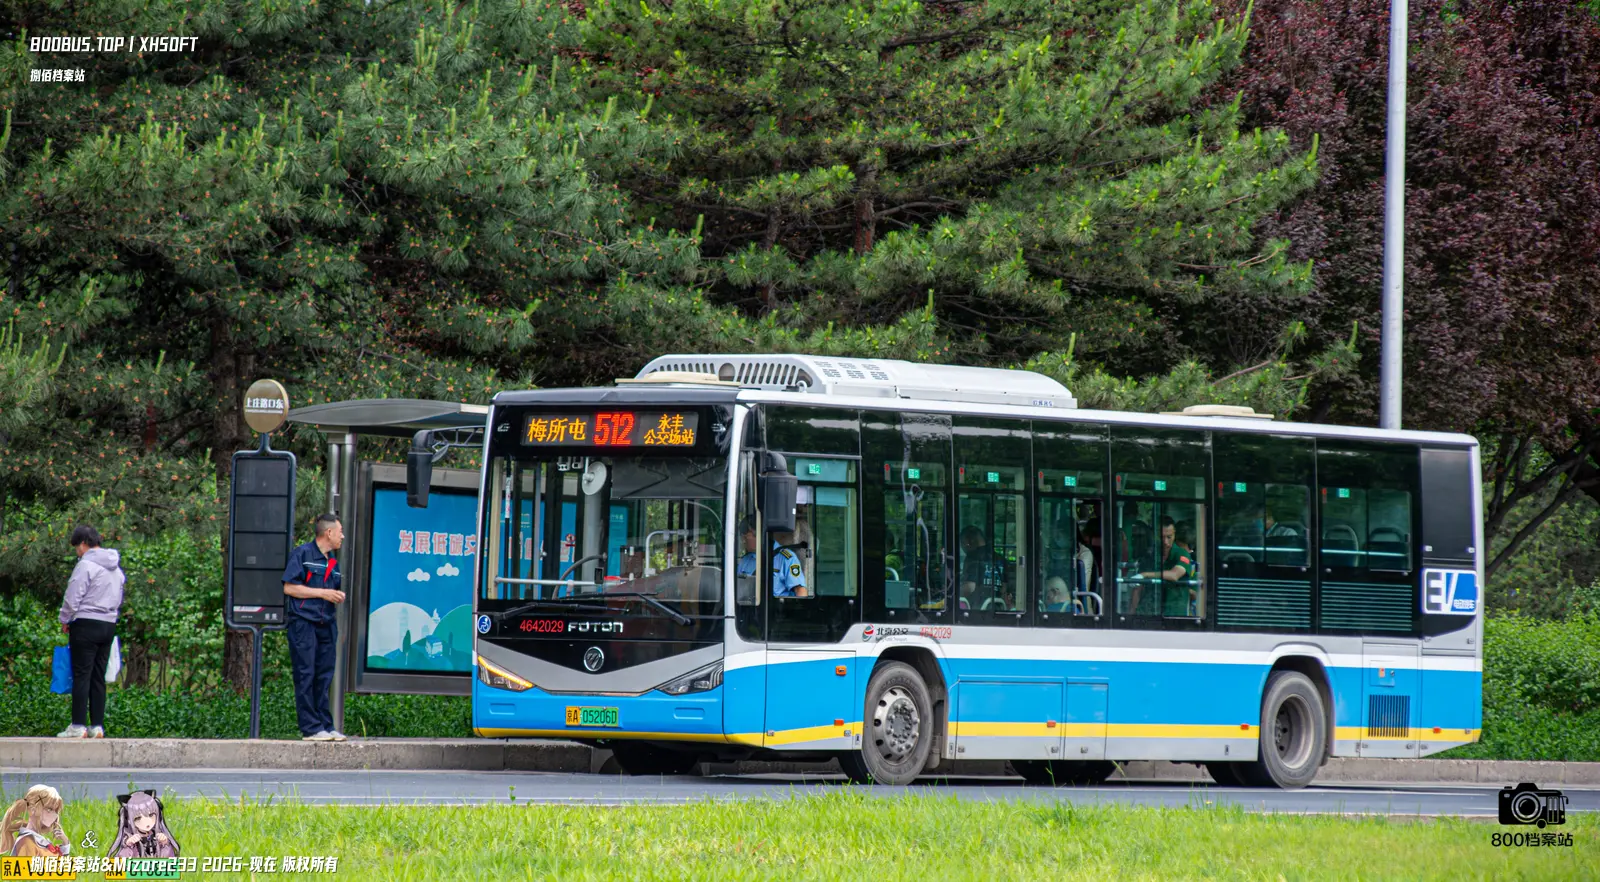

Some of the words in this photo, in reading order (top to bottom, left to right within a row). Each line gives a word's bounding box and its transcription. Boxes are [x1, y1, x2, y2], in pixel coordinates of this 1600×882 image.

[527, 418, 587, 443] 梅所屯
[594, 413, 635, 446] 512
[658, 413, 684, 431] 永丰
[643, 429, 695, 445] 公交场站
[519, 619, 564, 633] 4642029
[567, 621, 624, 633] FOTON
[876, 627, 909, 636] 北京公交
